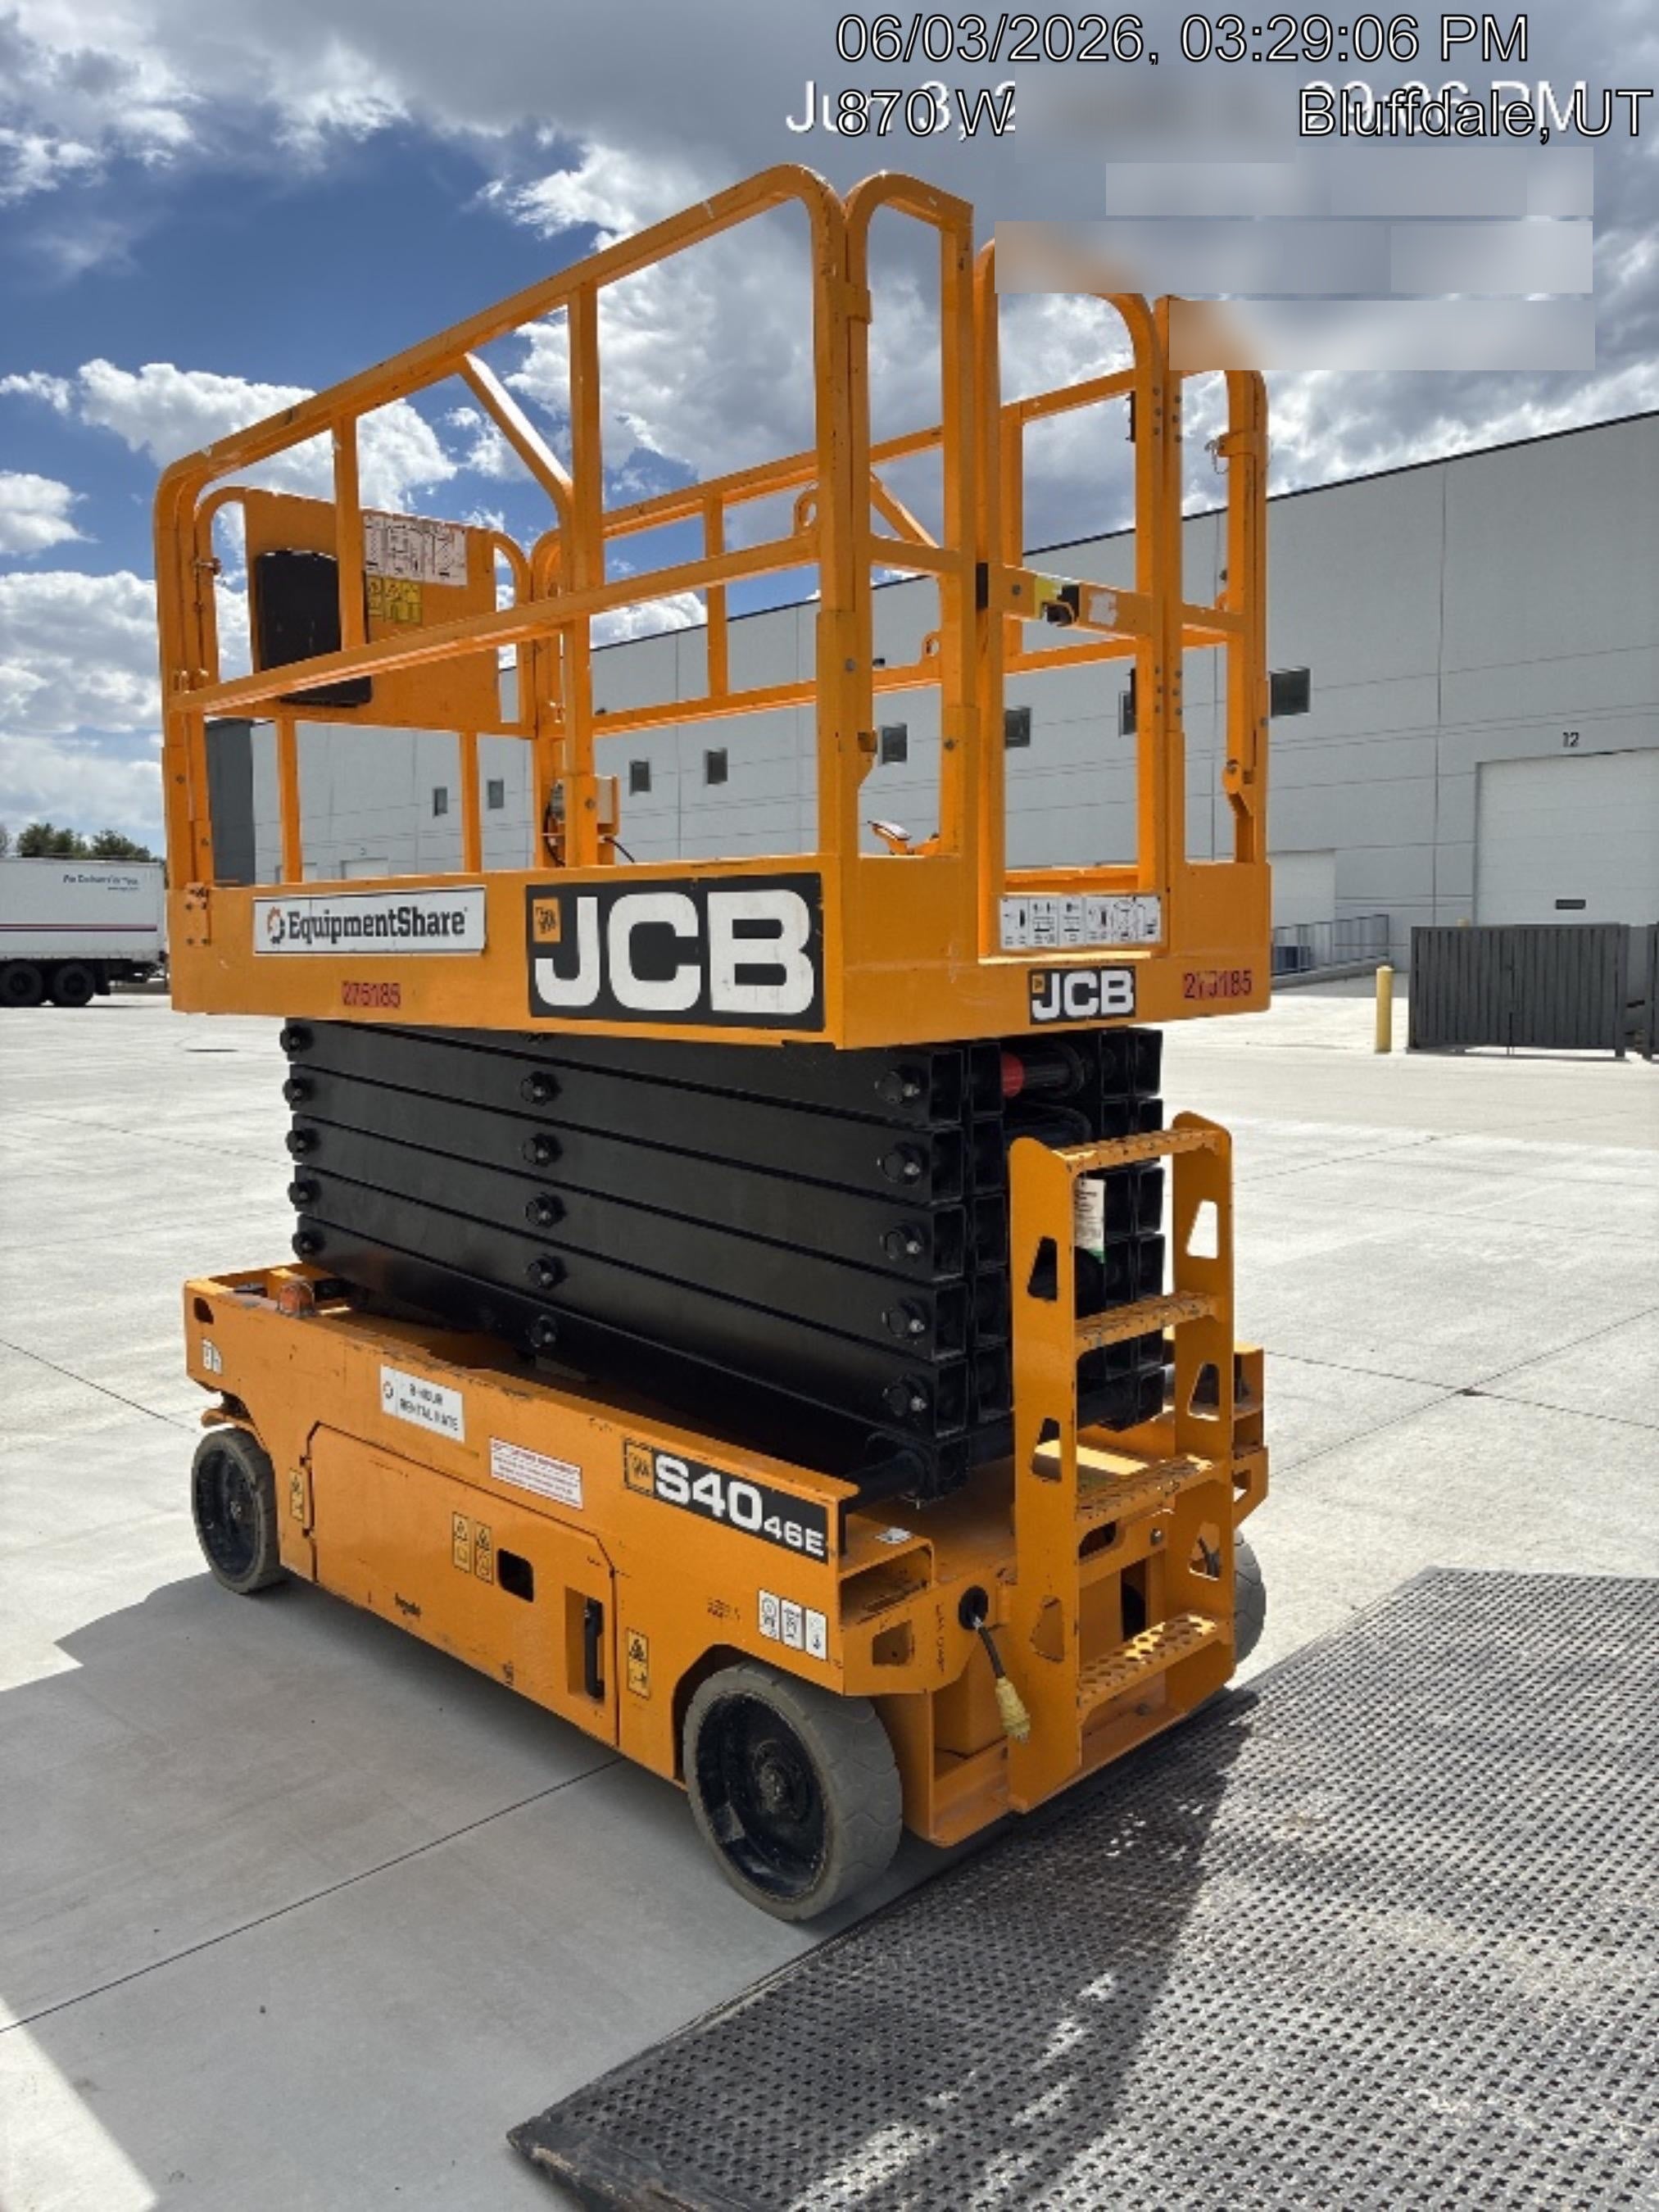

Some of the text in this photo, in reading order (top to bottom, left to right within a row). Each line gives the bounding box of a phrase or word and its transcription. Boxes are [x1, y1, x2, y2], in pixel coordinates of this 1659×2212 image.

[287, 906, 465, 945] EquipmentShare
[535, 889, 815, 1014] JCB
[342, 981, 401, 1009] 275185
[1031, 969, 1135, 1021] JCB
